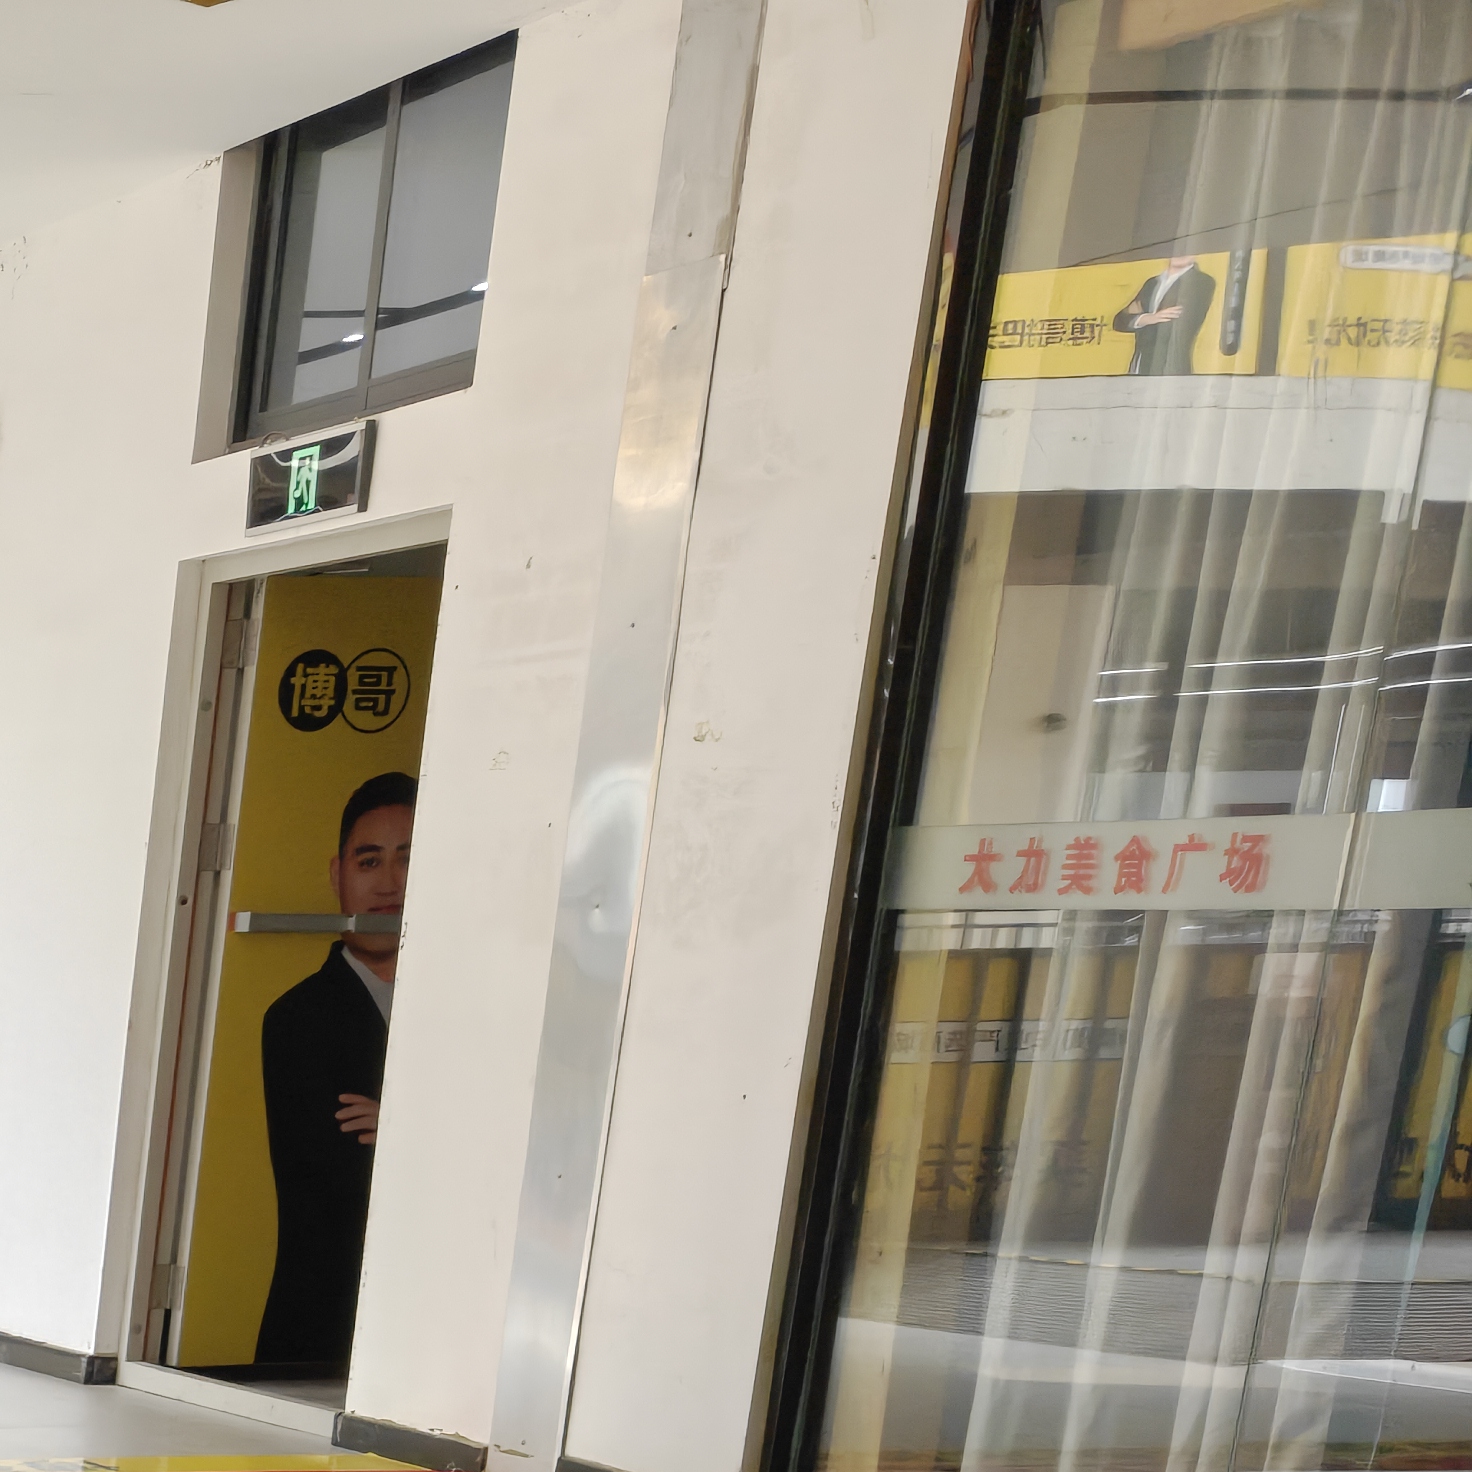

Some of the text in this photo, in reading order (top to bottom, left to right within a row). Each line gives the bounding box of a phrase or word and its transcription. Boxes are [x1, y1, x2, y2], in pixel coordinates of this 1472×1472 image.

[287, 660, 402, 723] 博哥
[958, 832, 1272, 895] 大力美食广场
